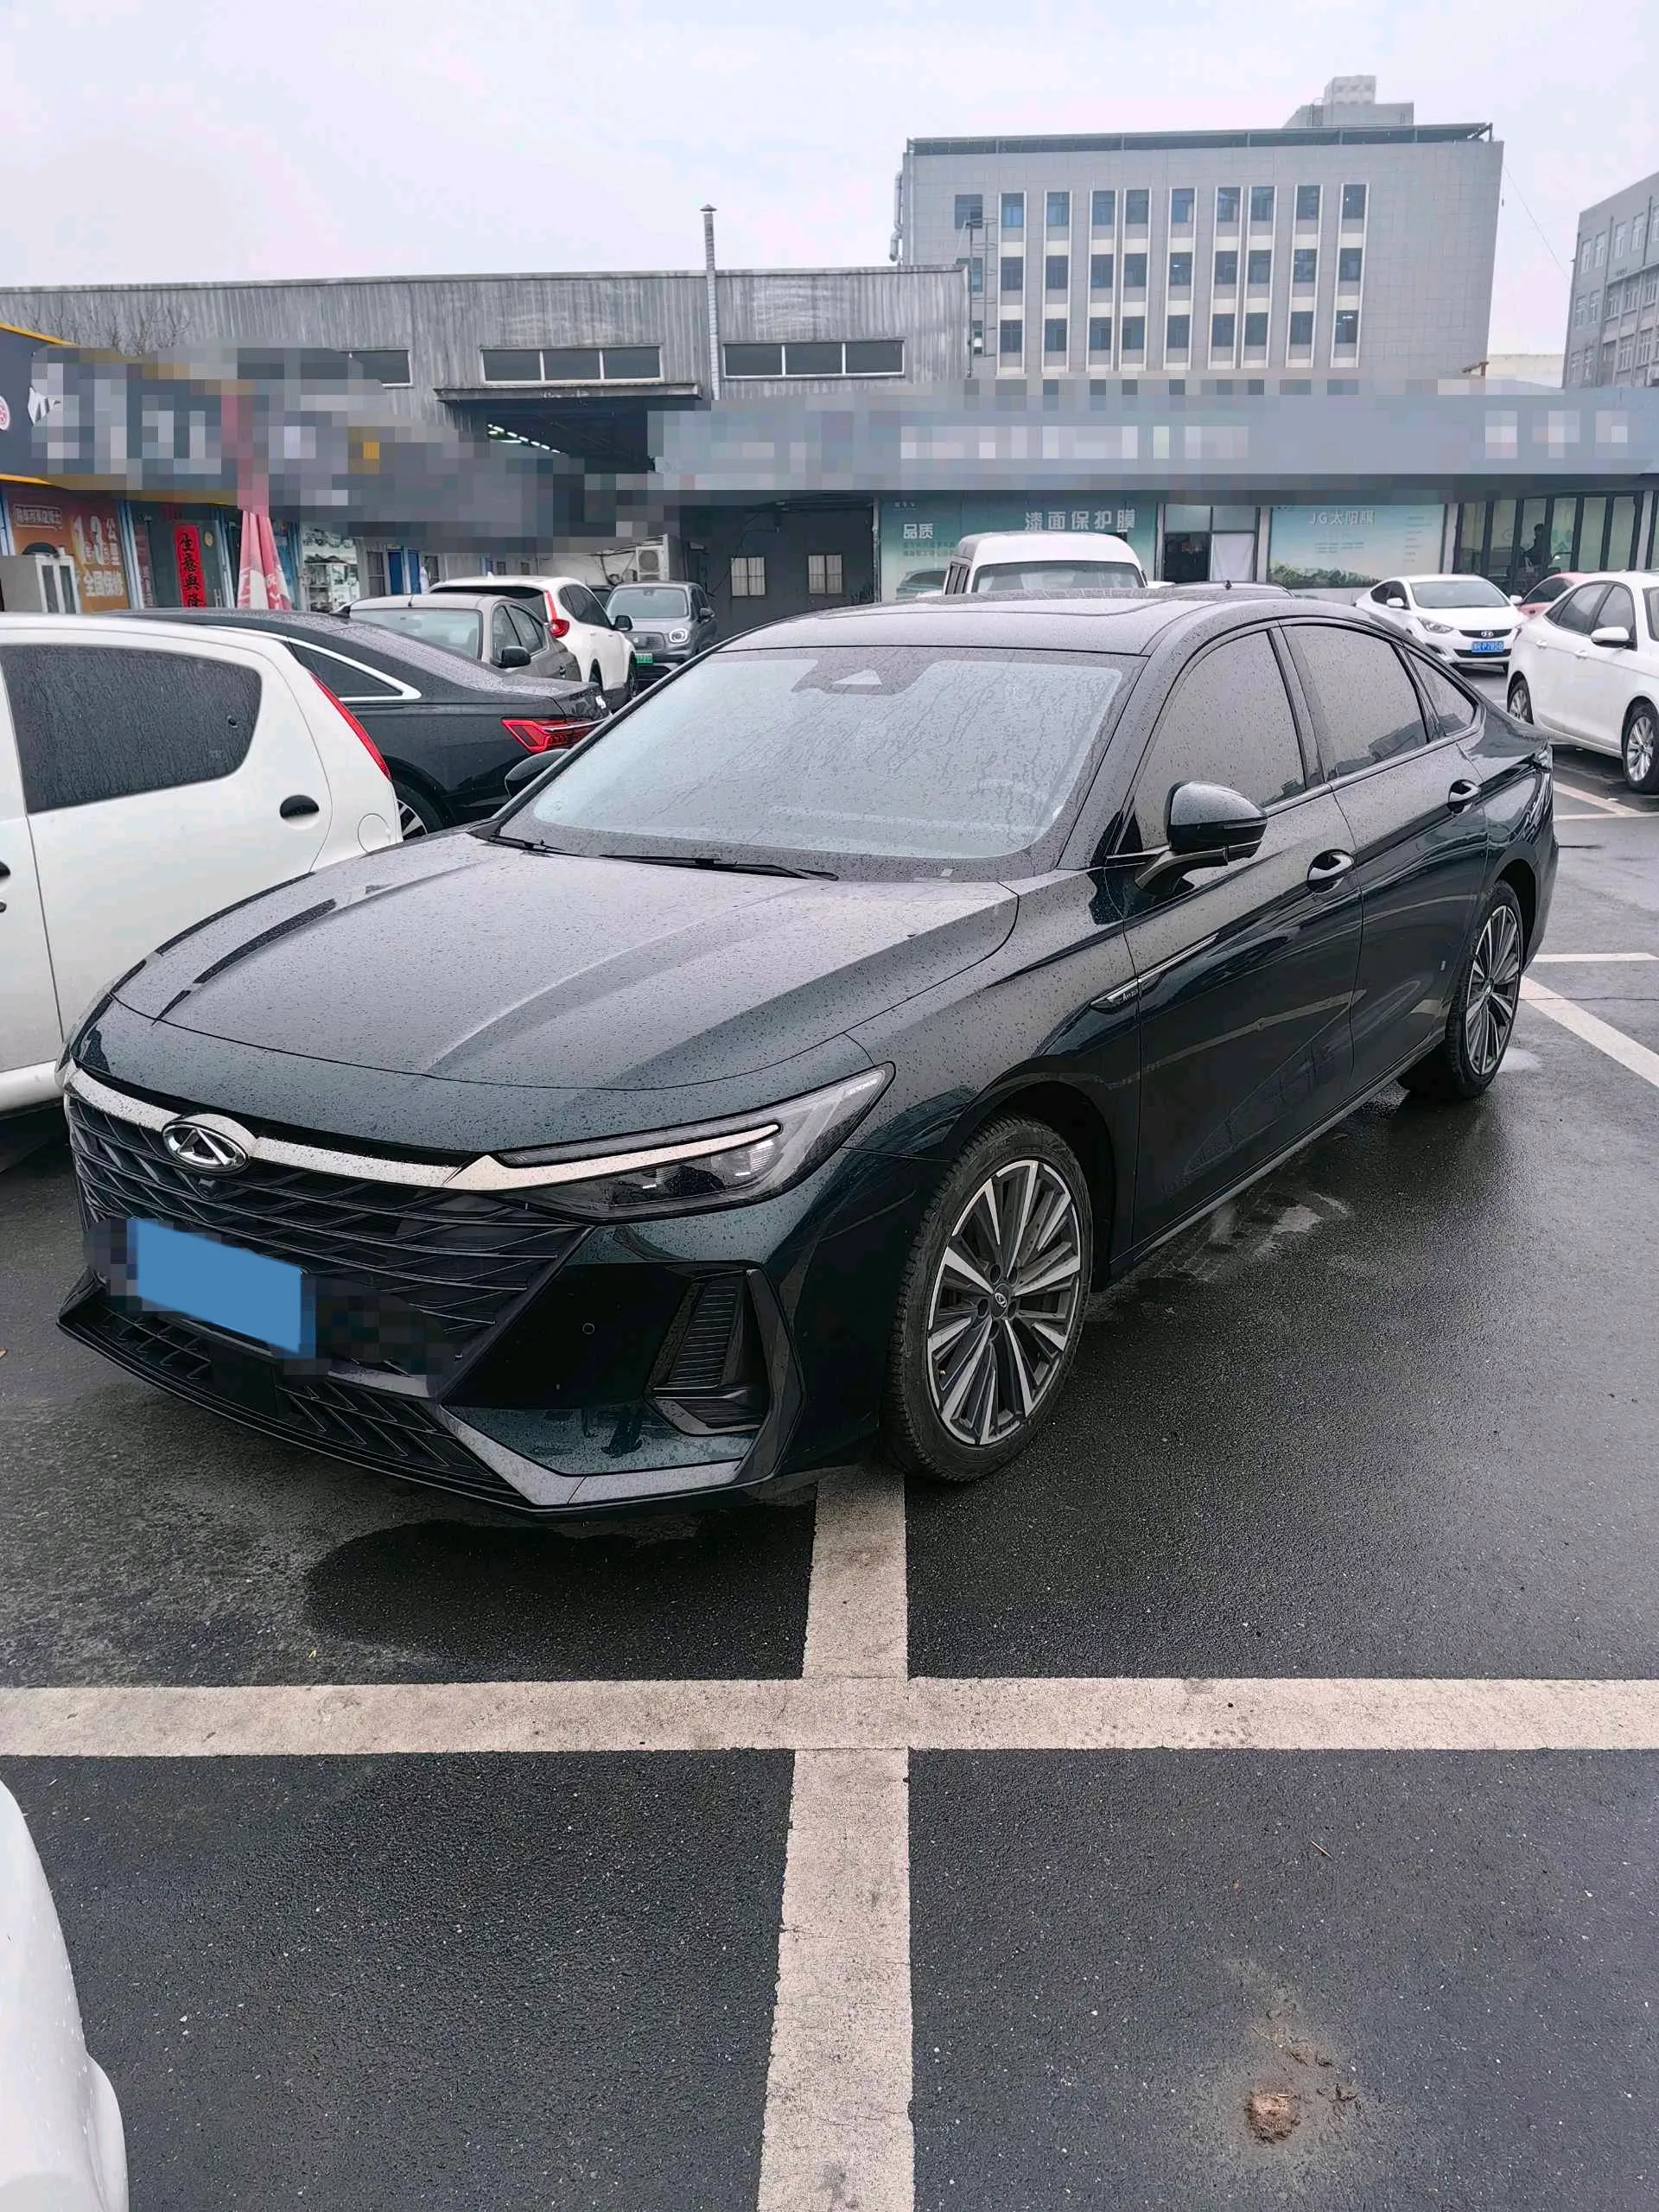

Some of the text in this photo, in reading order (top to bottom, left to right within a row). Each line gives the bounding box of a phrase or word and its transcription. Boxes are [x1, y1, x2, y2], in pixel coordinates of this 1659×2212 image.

[1025, 509, 1136, 531] 漆面保护膜
[903, 524, 933, 539] 品质
